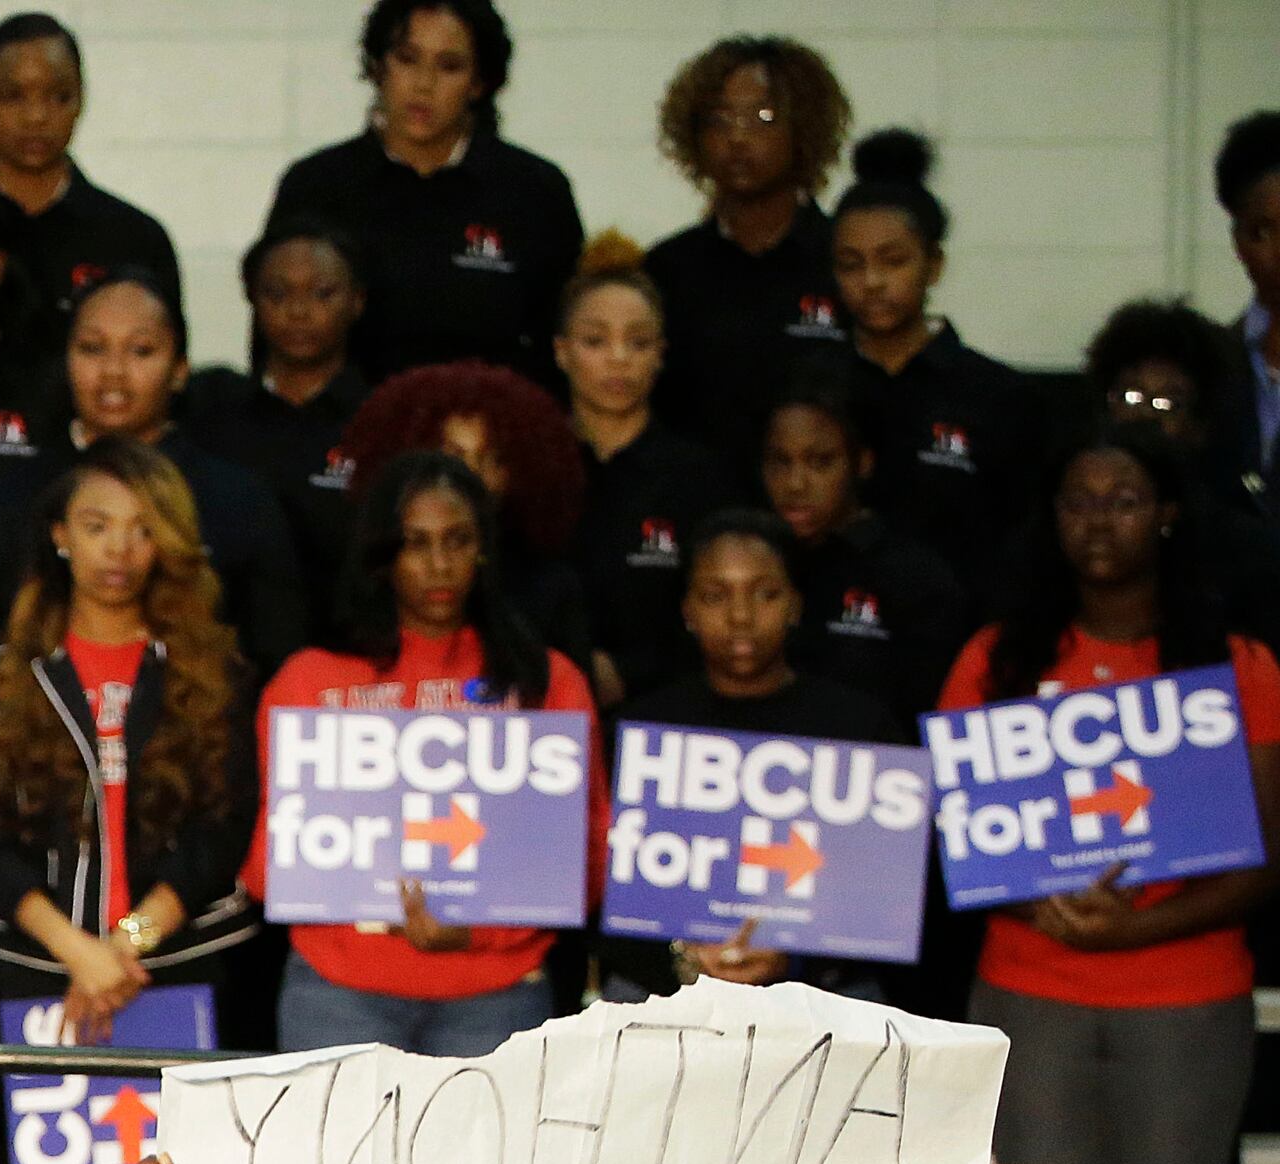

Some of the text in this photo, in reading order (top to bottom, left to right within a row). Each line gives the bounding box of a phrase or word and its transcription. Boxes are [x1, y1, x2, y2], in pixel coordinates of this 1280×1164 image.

[274, 712, 582, 796] HBCUs
[926, 676, 1236, 790] HBCUs
[617, 728, 926, 830] HBCUs
[268, 793, 390, 870] for
[608, 809, 729, 891] for
[935, 790, 1058, 860] for
